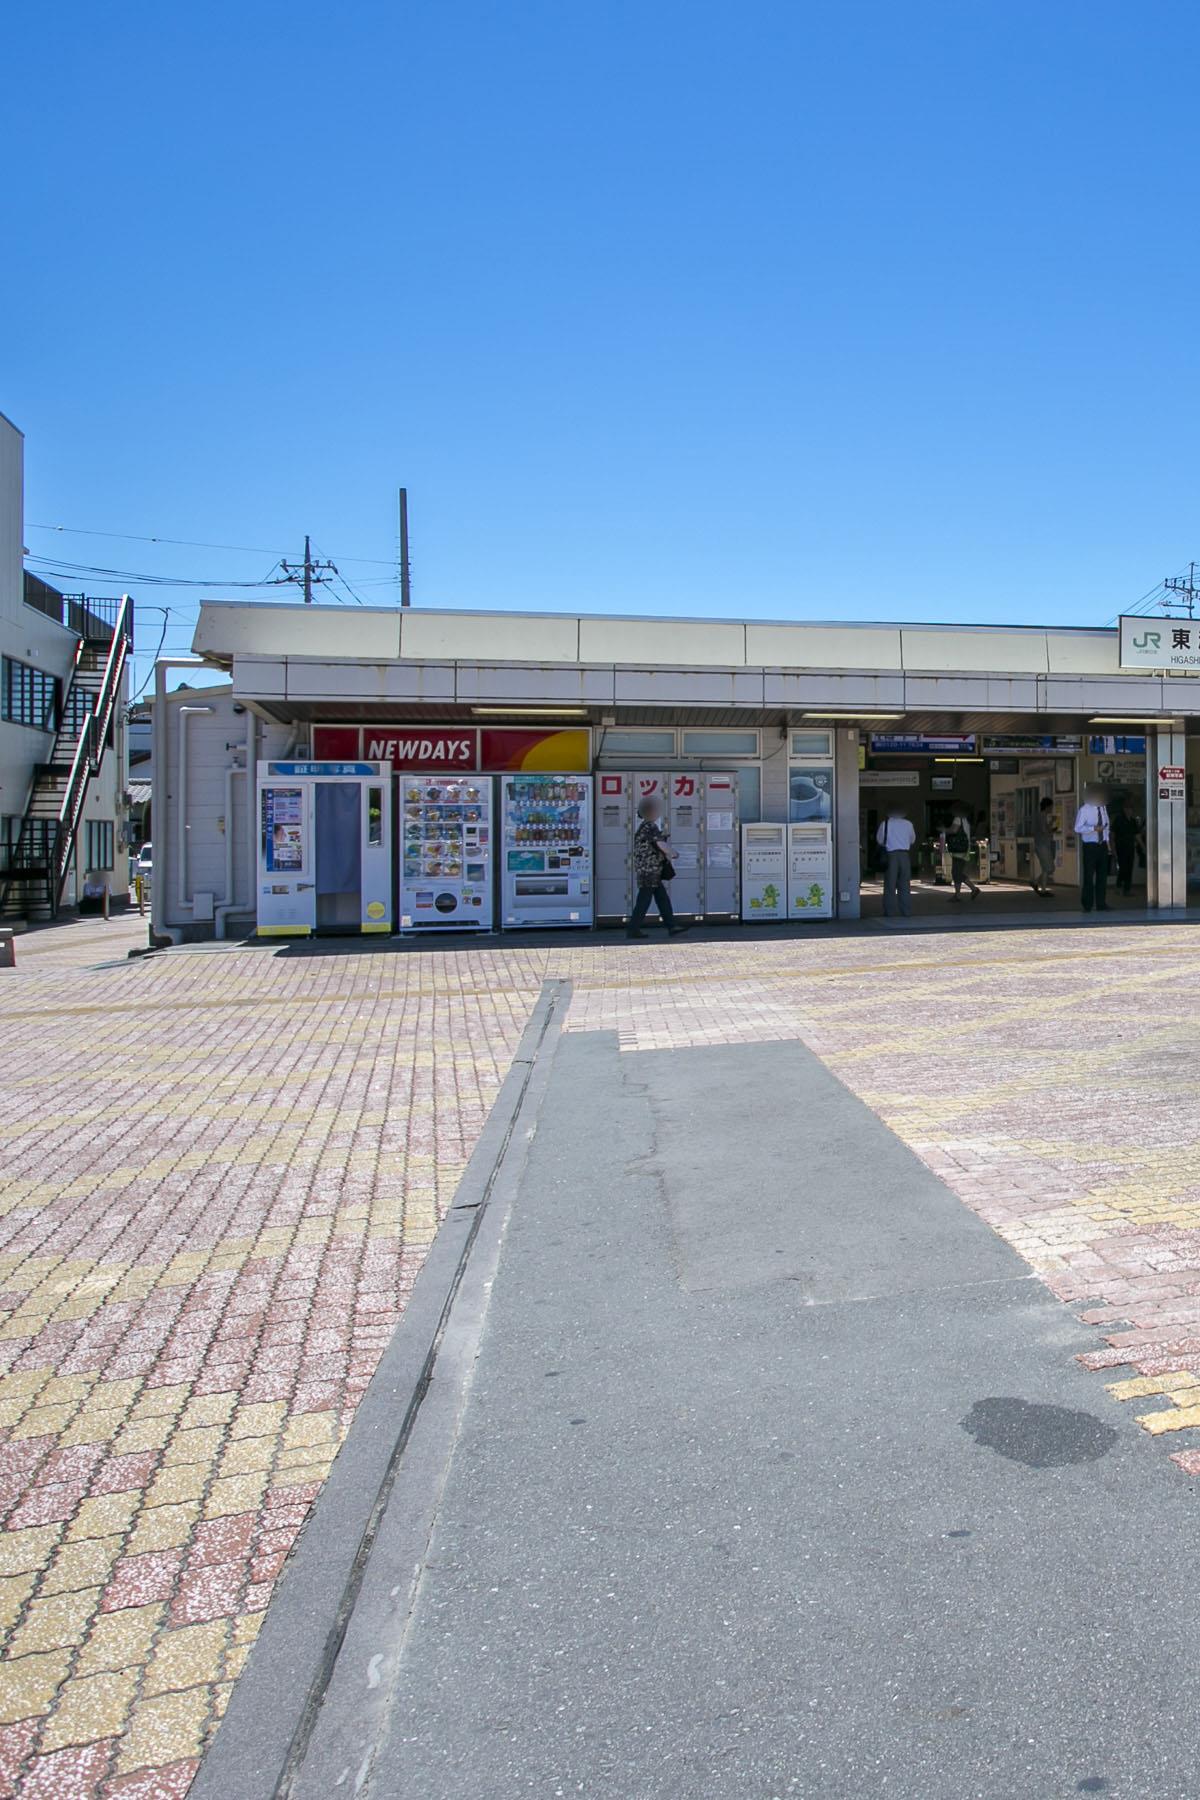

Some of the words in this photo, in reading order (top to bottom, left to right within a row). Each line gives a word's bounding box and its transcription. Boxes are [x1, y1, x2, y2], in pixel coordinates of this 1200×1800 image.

[1133, 631, 1162, 649] JR
[368, 740, 471, 760] NEWDAYS
[601, 775, 731, 797] ロッカー
